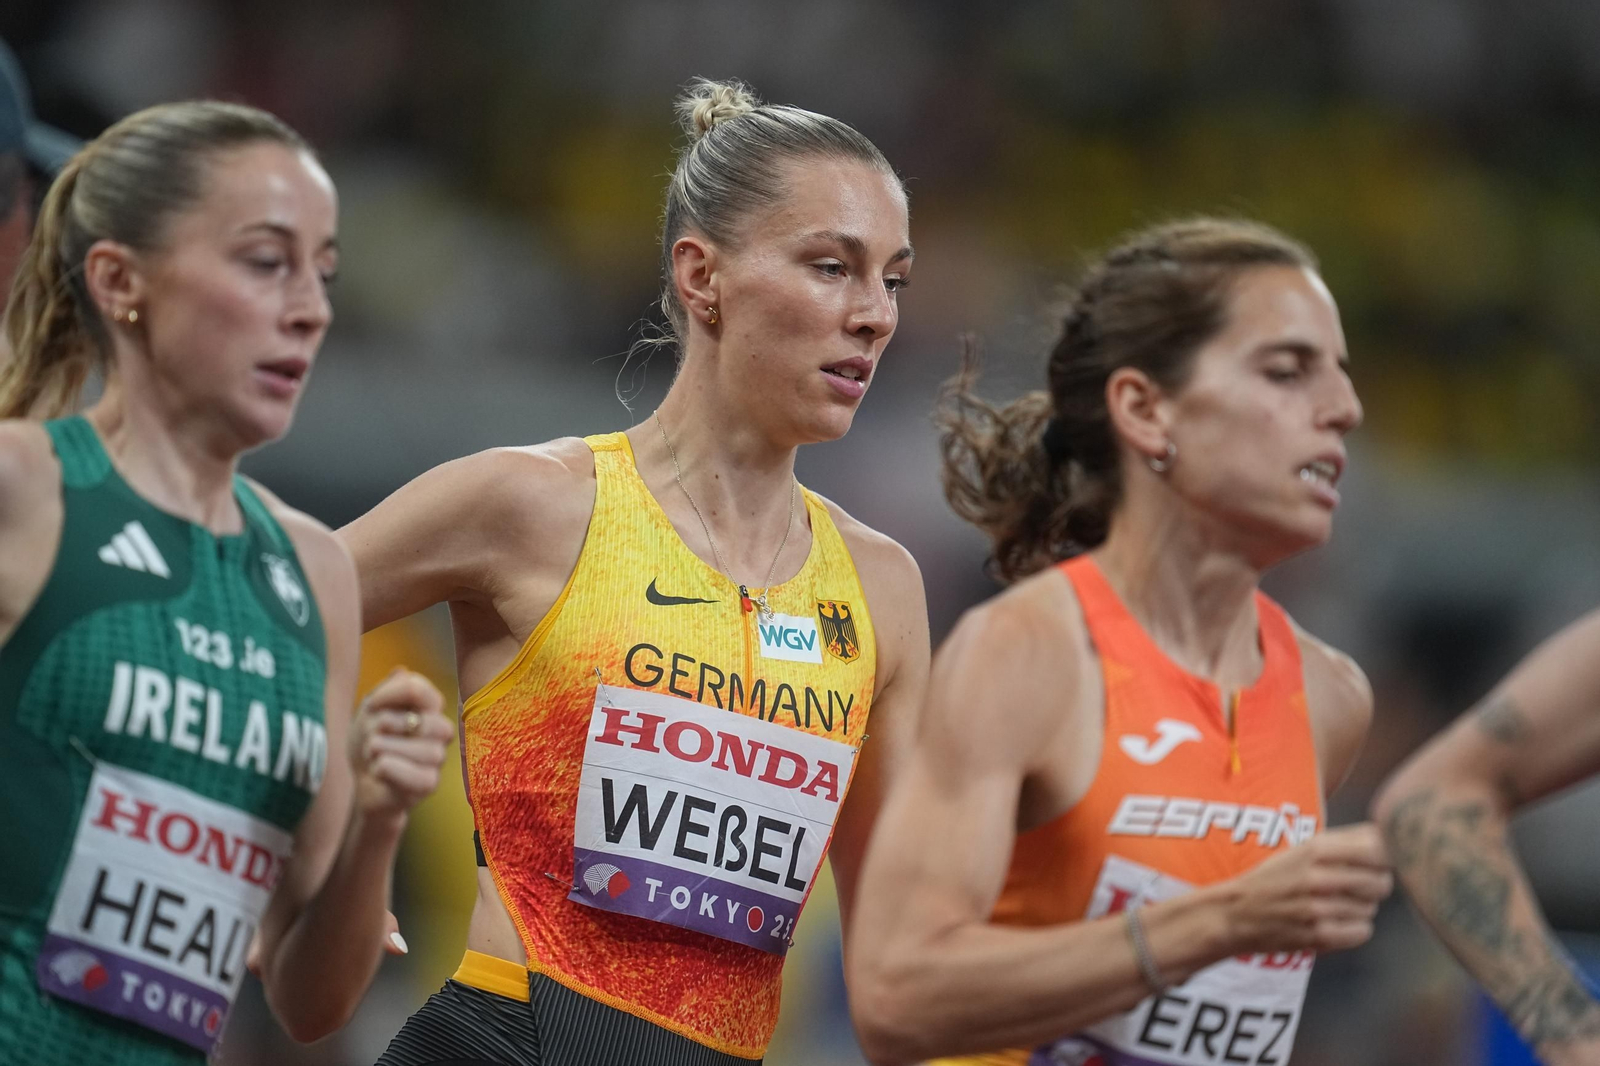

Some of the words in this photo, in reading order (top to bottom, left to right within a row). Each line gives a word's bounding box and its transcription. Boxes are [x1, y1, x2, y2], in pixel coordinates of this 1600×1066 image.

[758, 624, 816, 651] WGV
[624, 643, 854, 735] GERMANY
[594, 706, 840, 803] HONDA
[79, 866, 255, 983] HEAL
[645, 877, 765, 933] TOKYO
[120, 971, 223, 1037] TOKYO
